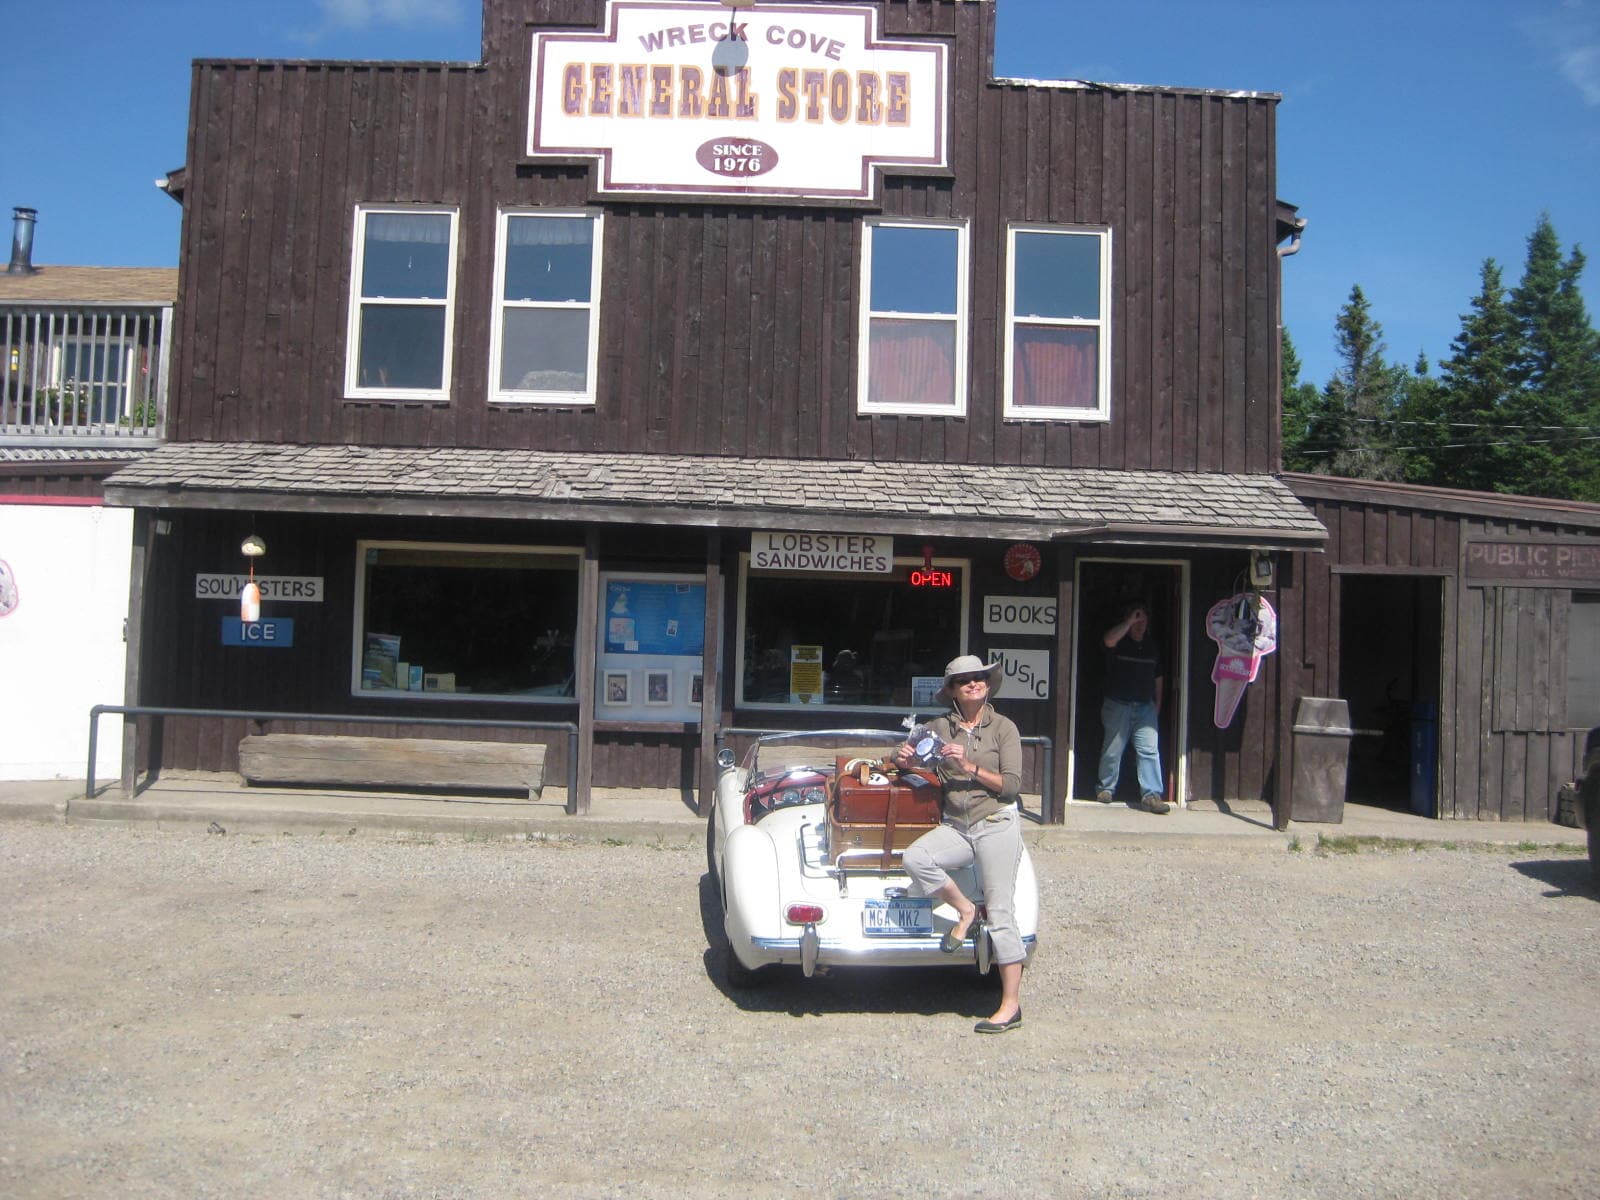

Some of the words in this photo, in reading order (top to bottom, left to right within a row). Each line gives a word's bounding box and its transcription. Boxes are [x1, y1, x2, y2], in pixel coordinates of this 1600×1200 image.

[638, 22, 749, 53] WRECK
[766, 25, 846, 61] COVE
[561, 62, 759, 122] GENERAL
[776, 67, 911, 127] STORE
[713, 144, 762, 157] SINCE
[714, 158, 761, 172] 1976
[768, 534, 877, 554] LOBSTER
[756, 551, 887, 571] SANDWICHES
[1468, 545, 1548, 566] PUBLIC
[911, 571, 951, 586] OPEN
[989, 603, 1057, 625] BOOKS
[241, 623, 275, 640] ICE
[991, 651, 1047, 698] MUSIC
[869, 909, 890, 927] MGA
[898, 909, 920, 927] MK2
